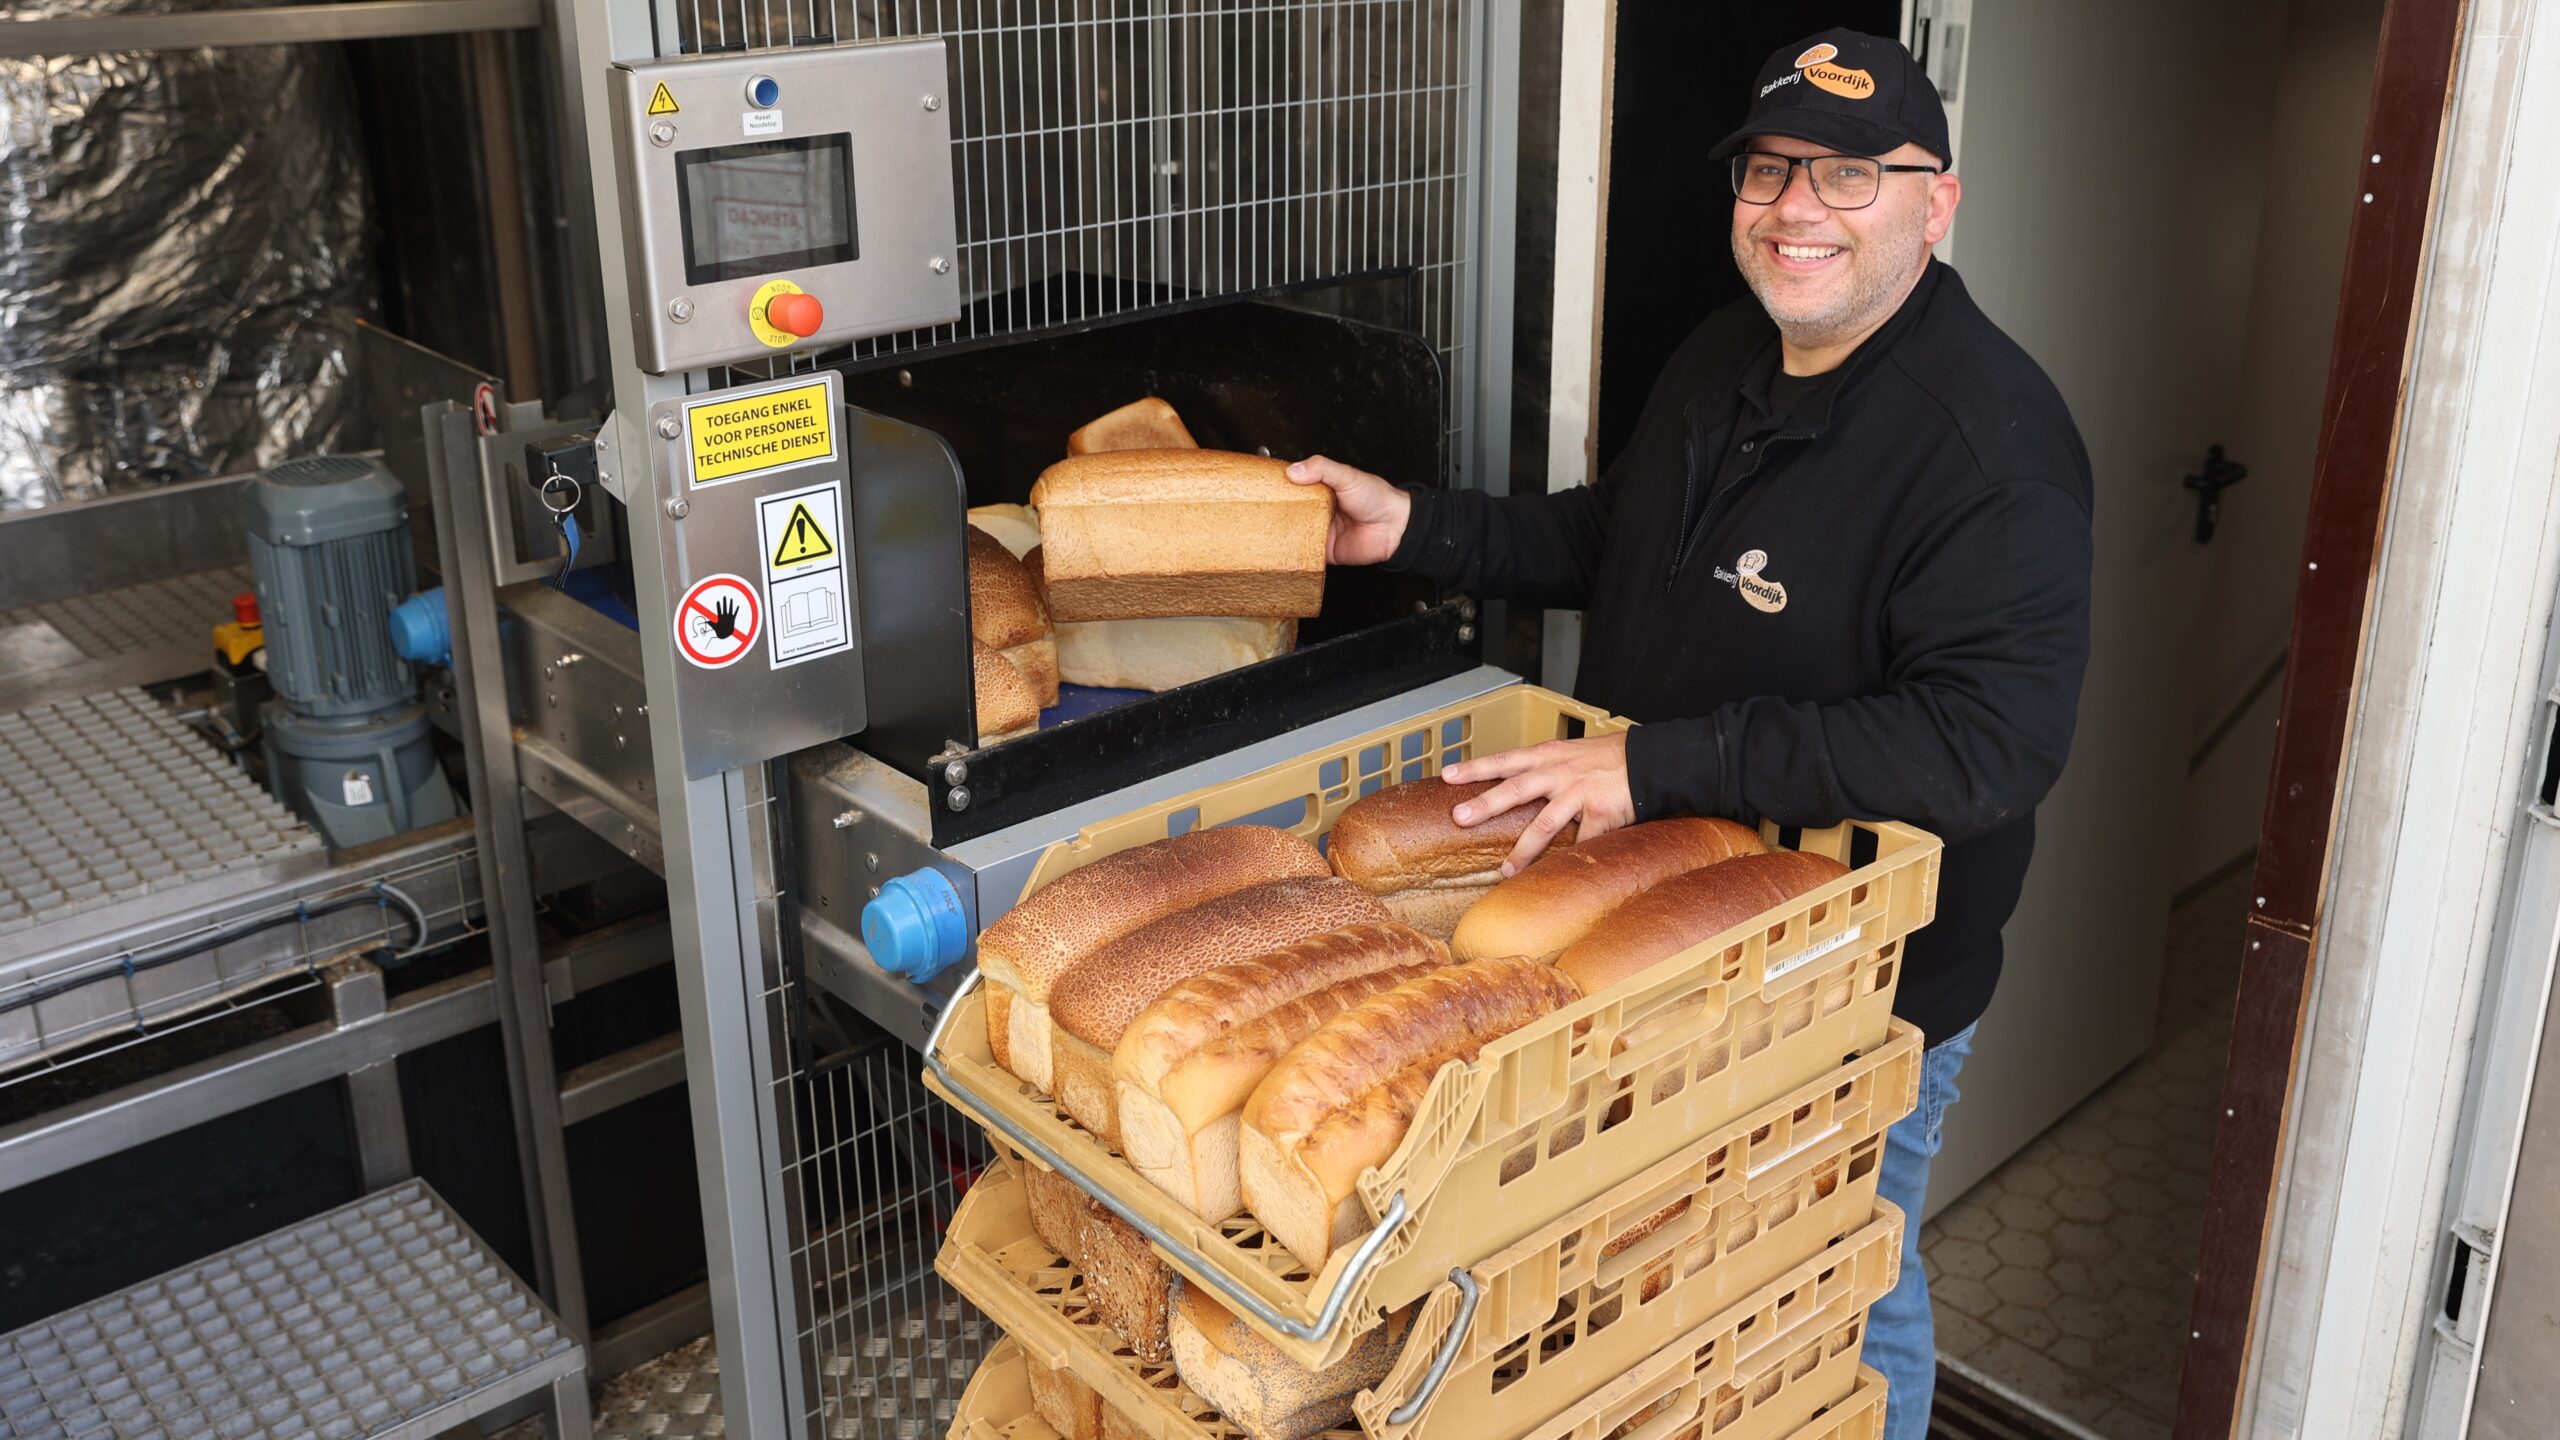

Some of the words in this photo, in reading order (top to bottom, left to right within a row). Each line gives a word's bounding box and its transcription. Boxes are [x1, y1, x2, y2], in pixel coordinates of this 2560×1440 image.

[1760, 69, 1802, 98] Bakkerij
[1809, 68, 1870, 90] Voordijk
[750, 121, 777, 129] Noodstop
[771, 284, 791, 294] NOOD
[769, 334, 787, 343] STOP
[706, 406, 769, 428] TOEGANG
[773, 398, 812, 415] ENKEL
[704, 430, 742, 447] VOOR
[745, 416, 817, 439] PERSONEEL
[698, 441, 779, 467] TECHNISCHE
[781, 431, 826, 450] DIENST
[1741, 577, 1784, 604] Voordijk
